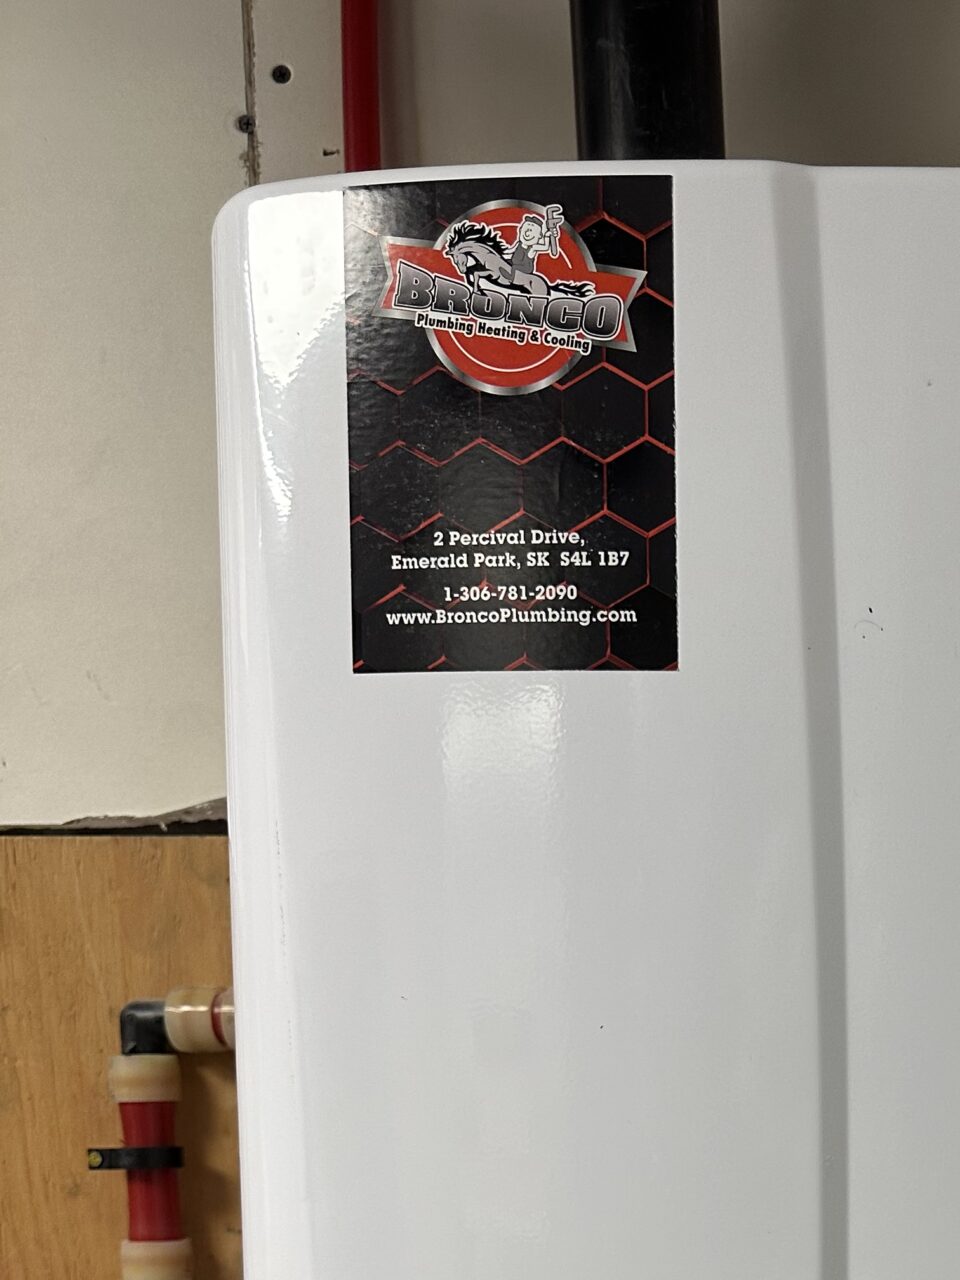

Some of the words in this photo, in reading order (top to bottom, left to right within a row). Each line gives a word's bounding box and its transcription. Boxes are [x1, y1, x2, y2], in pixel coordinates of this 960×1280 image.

[394, 258, 624, 339] BRONCO
[416, 312, 474, 336] Plumbing
[477, 323, 526, 343] Heating
[530, 329, 540, 342] &
[544, 332, 590, 353] Cooling
[433, 531, 444, 546] 2
[449, 530, 526, 546] Percival
[530, 529, 585, 547] Drive,
[391, 553, 468, 570] Emerald
[473, 553, 521, 570] Park,
[526, 552, 550, 567] SK
[560, 551, 592, 567] S4L
[598, 551, 630, 566] 1B7
[444, 585, 578, 602] 1-306-781-2090
[386, 607, 638, 627] www.BroncoPlumbing.com
